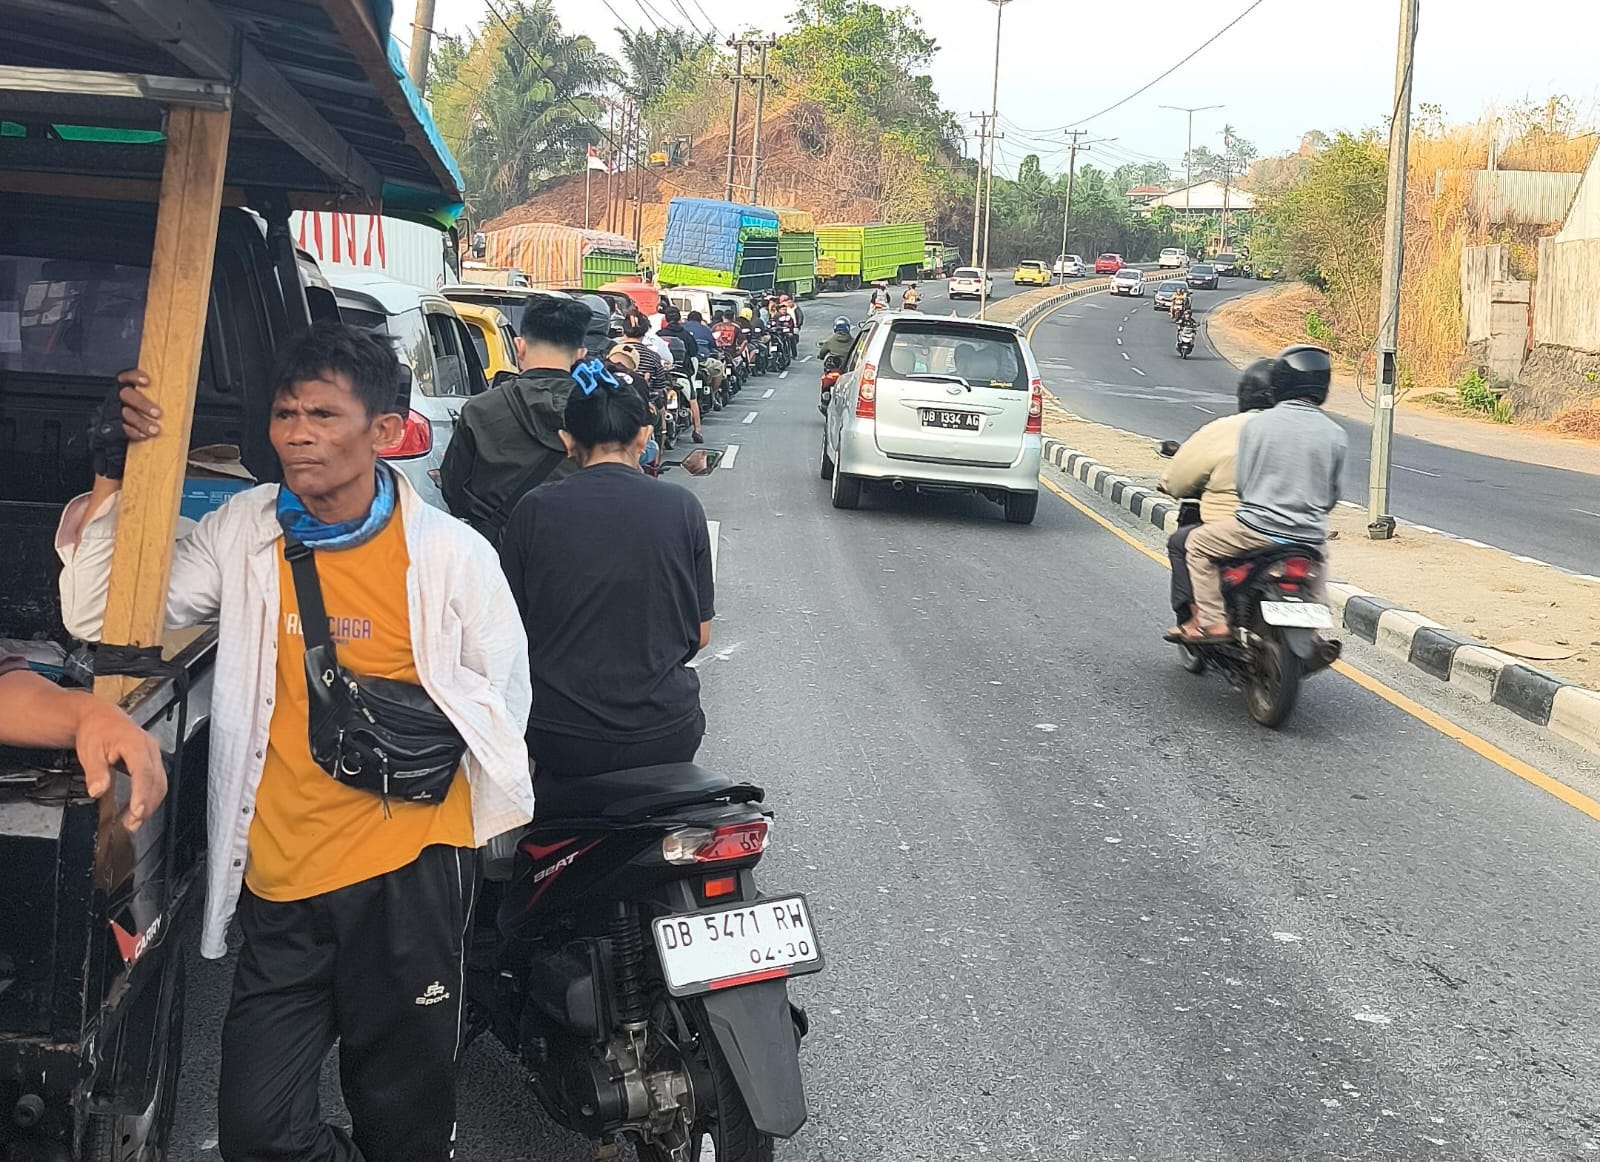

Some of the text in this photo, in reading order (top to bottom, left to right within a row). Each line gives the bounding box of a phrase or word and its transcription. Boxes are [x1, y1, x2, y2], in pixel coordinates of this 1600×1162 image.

[941, 411, 961, 425] 1334
[965, 414, 980, 426] AG
[134, 912, 162, 960] CARRY
[662, 903, 804, 950] DB 5471 RW
[415, 992, 451, 1006] Sport
